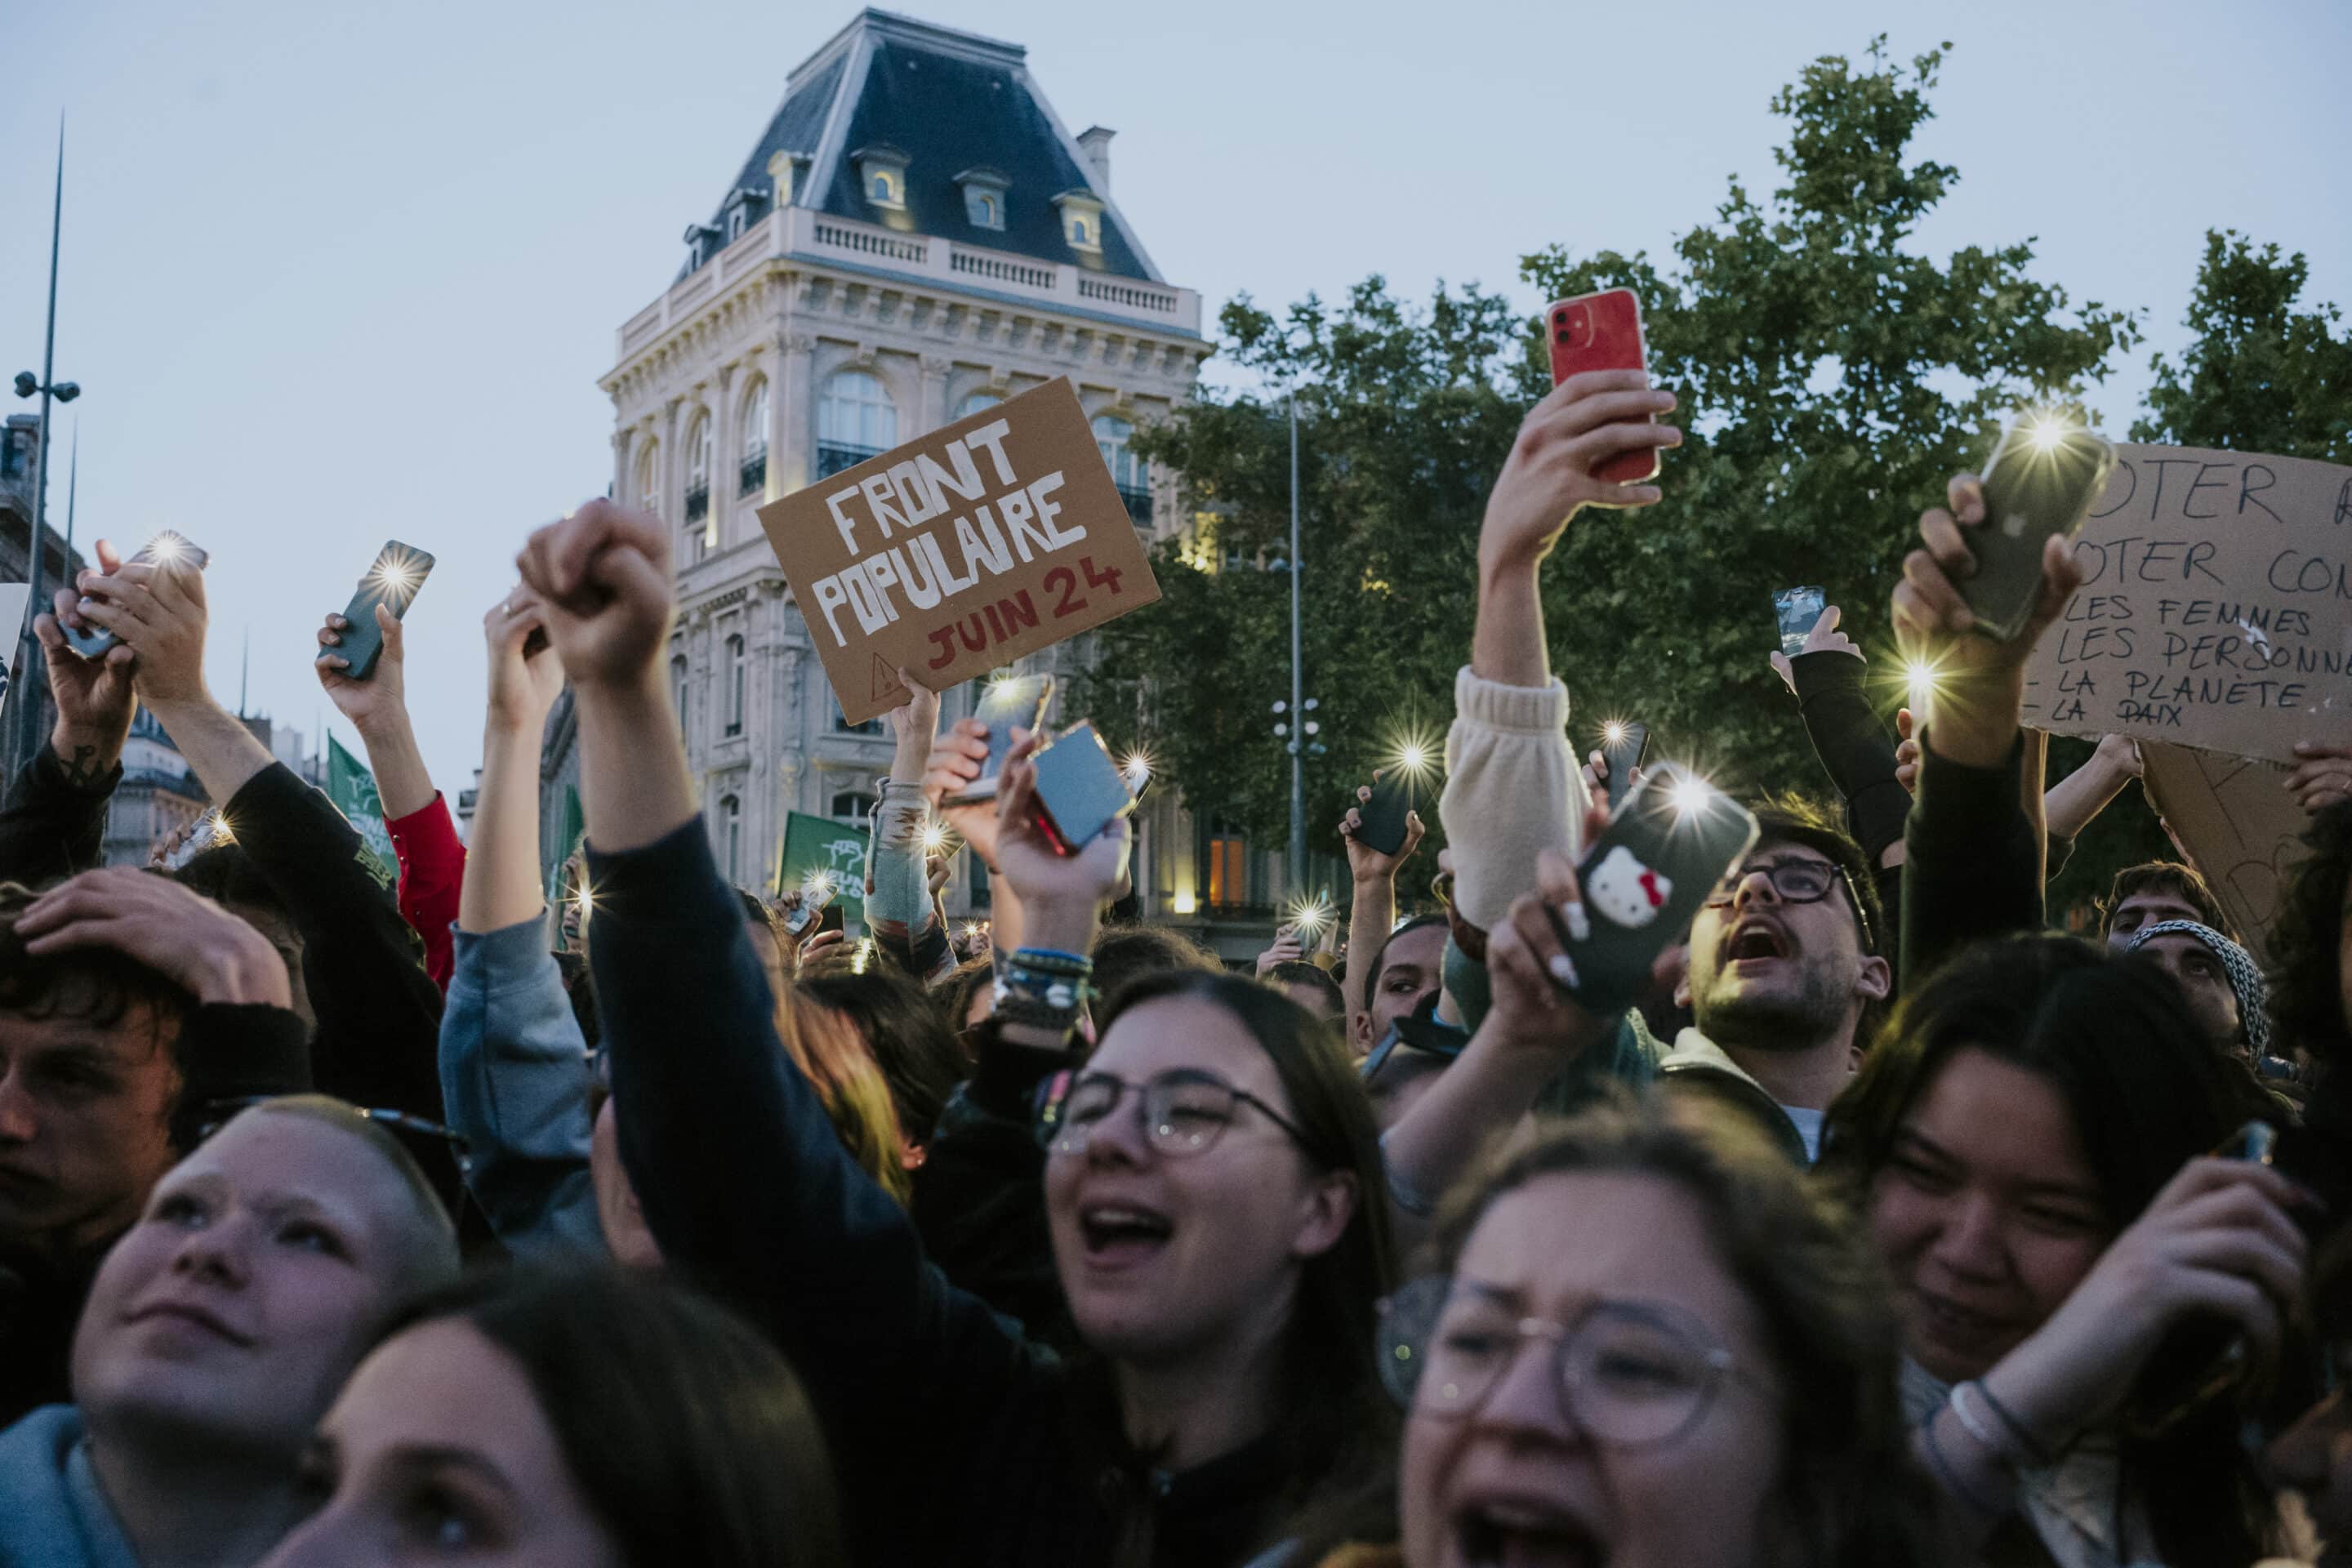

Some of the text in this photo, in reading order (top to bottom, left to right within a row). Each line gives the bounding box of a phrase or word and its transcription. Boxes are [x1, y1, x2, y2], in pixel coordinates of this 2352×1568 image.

[825, 417, 1018, 556] FRONT
[2087, 459, 2283, 523] OTER
[811, 470, 1087, 648] POPULAIRE
[2072, 537, 2225, 586] OTER
[927, 555, 1123, 670] JUIN 24
[2065, 595, 2310, 636] LES FEMMES
[2058, 628, 2136, 665] LES
[2051, 697, 2182, 727] LA PAIX
[2057, 670, 2307, 708] LA PLANÈTE
